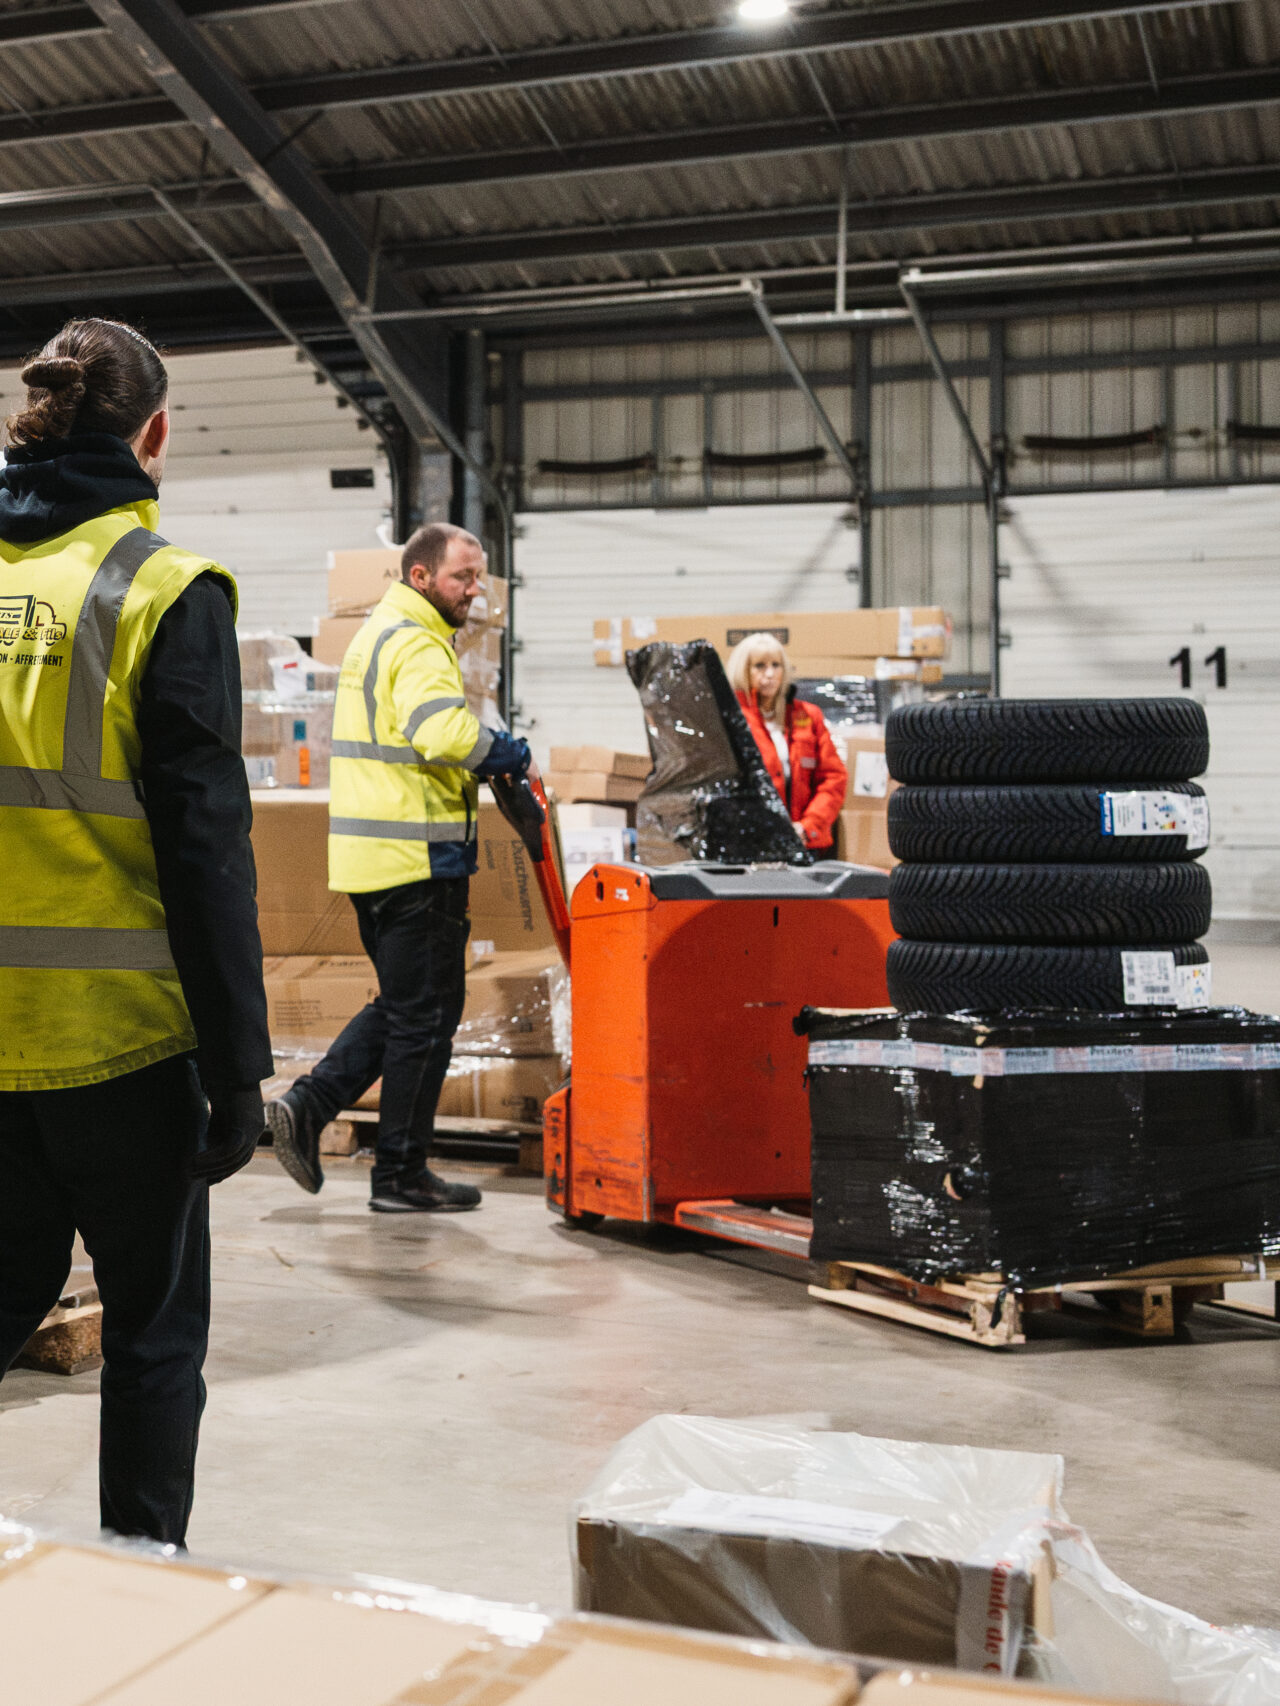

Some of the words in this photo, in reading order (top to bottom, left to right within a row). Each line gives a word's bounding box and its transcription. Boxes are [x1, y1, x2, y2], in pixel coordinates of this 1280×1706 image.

[22, 628, 38, 641] &
[40, 628, 63, 641] Fils
[1169, 646, 1227, 689] 11
